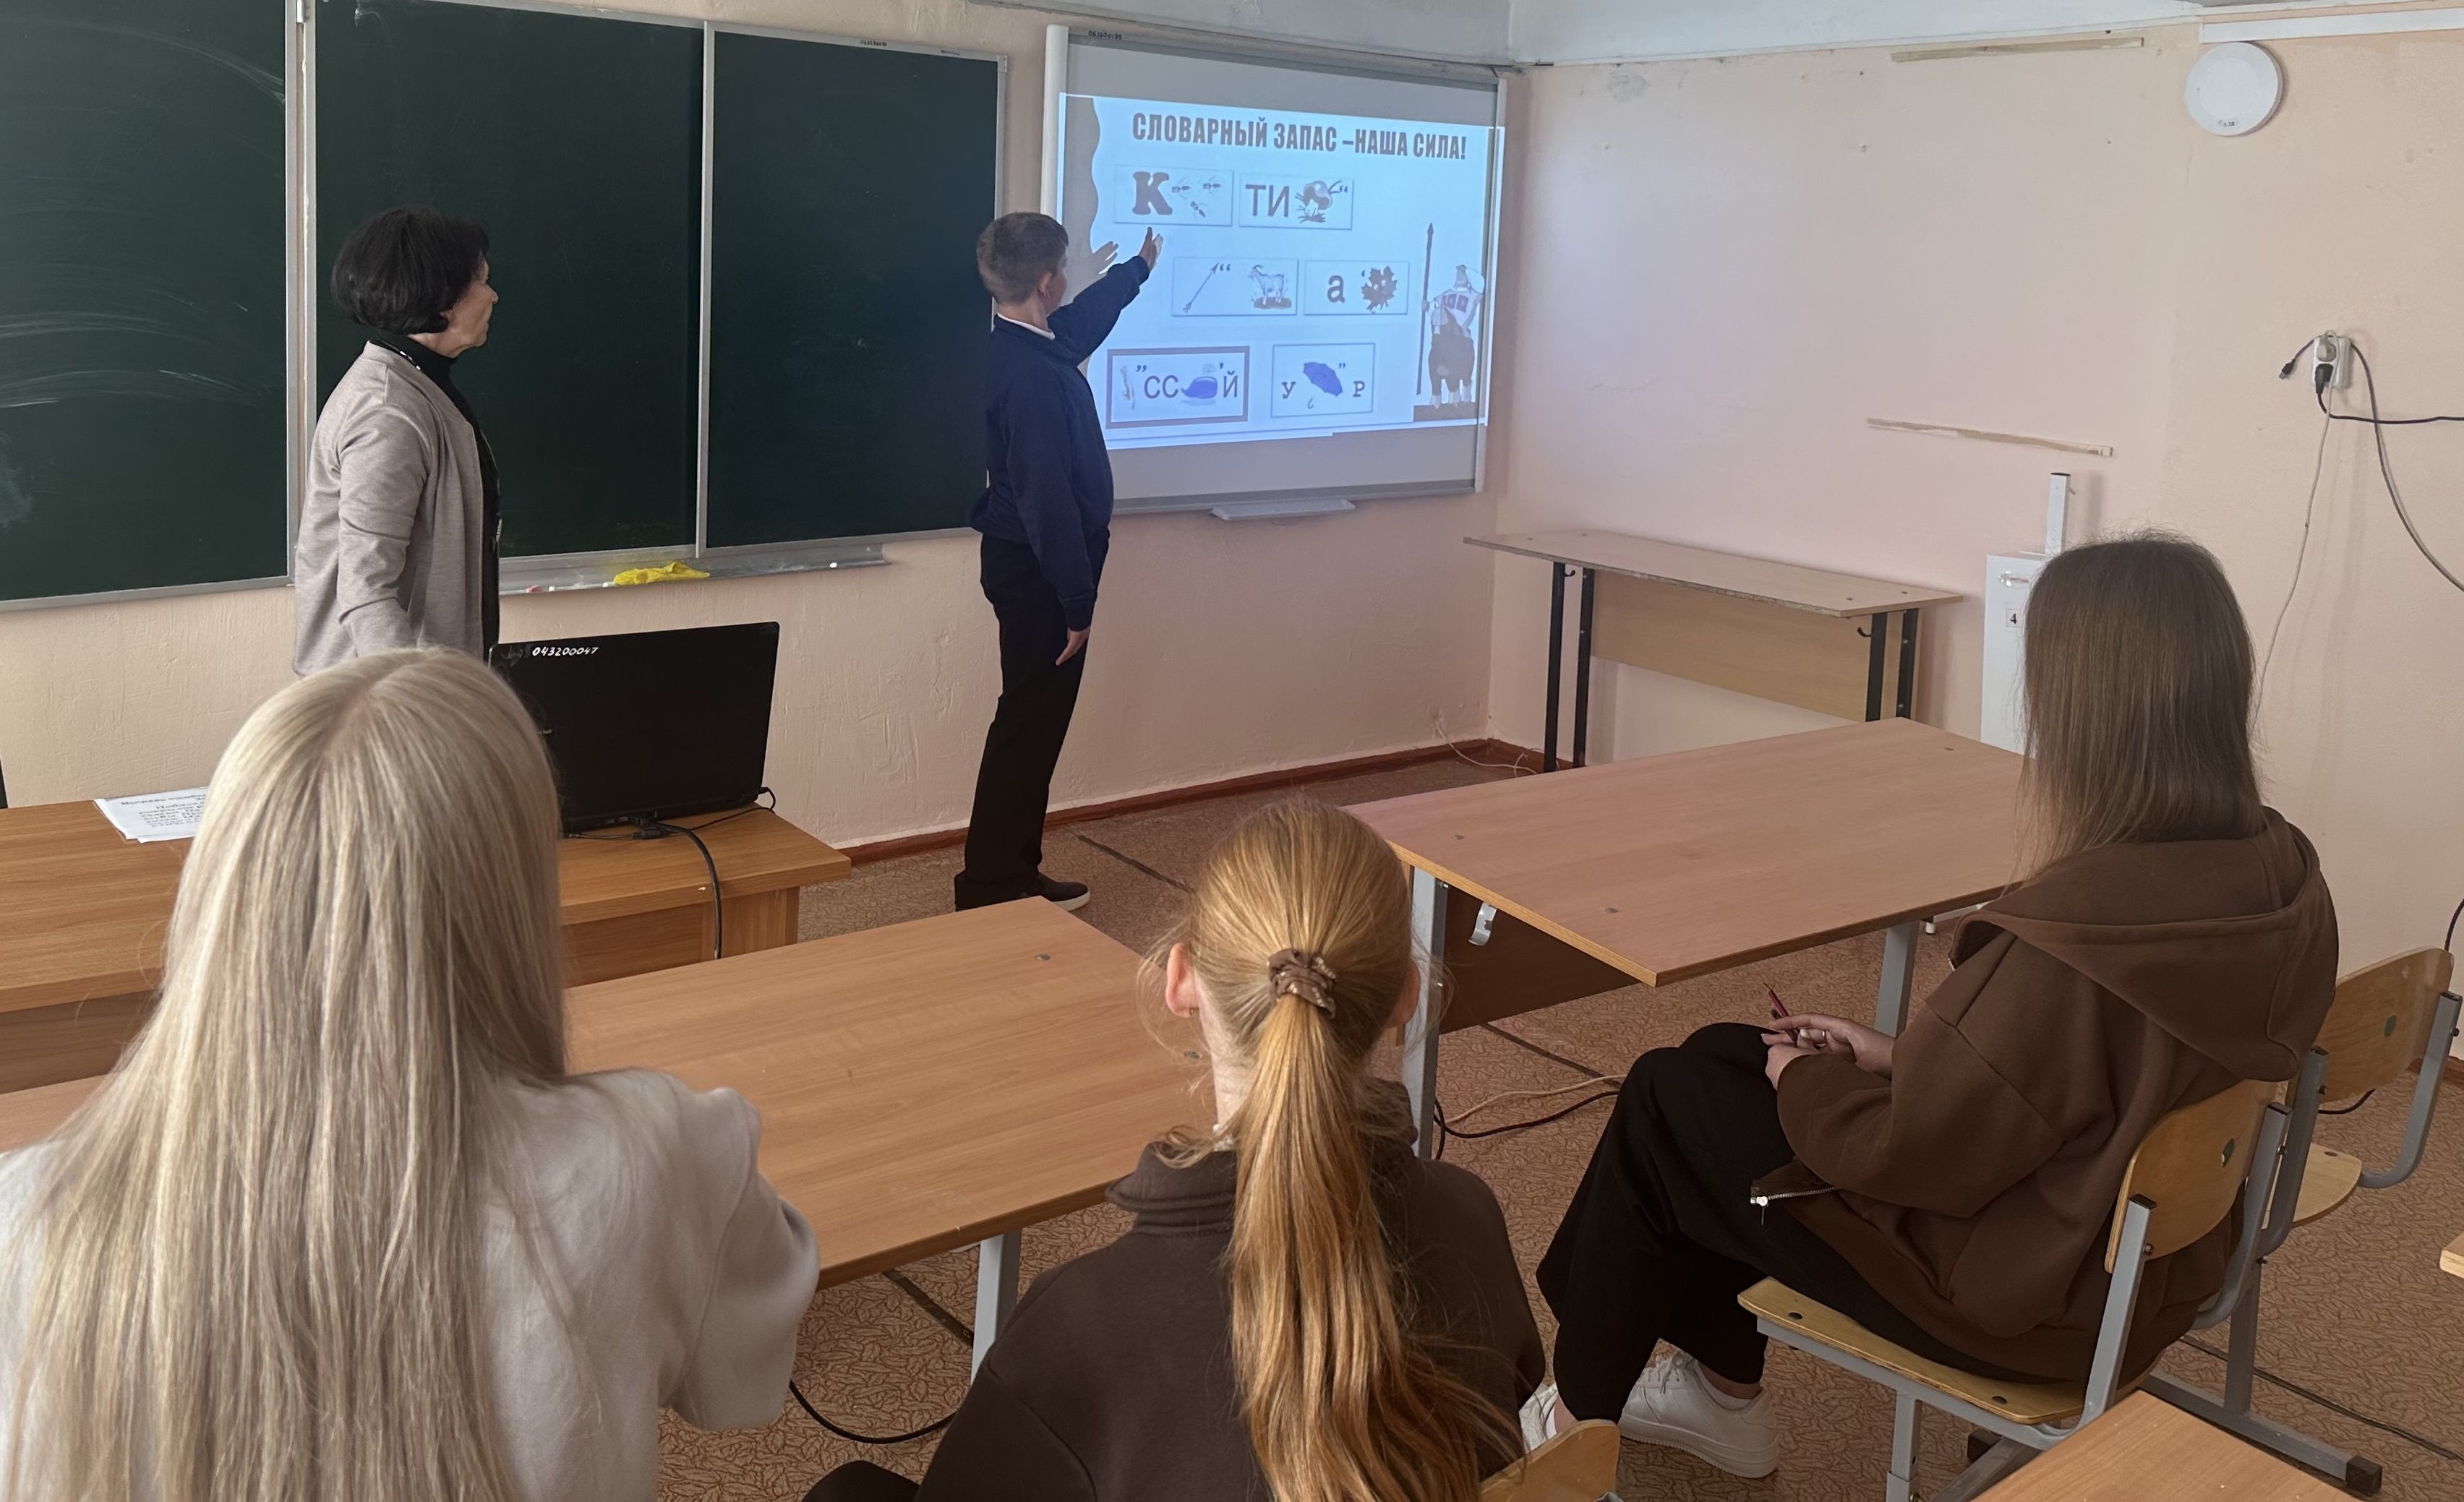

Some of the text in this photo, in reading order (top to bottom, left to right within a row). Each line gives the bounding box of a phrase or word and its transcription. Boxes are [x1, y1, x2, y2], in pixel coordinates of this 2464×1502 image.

[1132, 112, 1267, 148] СЛОВАРНЫЙ
[1273, 123, 1337, 152] ЗАПАС
[1413, 132, 1467, 160] СИЛА!
[1245, 184, 1290, 217] ТИ
[1327, 275, 1346, 303] а
[1223, 370, 1238, 398] Й
[2010, 613, 2017, 625] 4
[532, 646, 599, 656] 043200047
